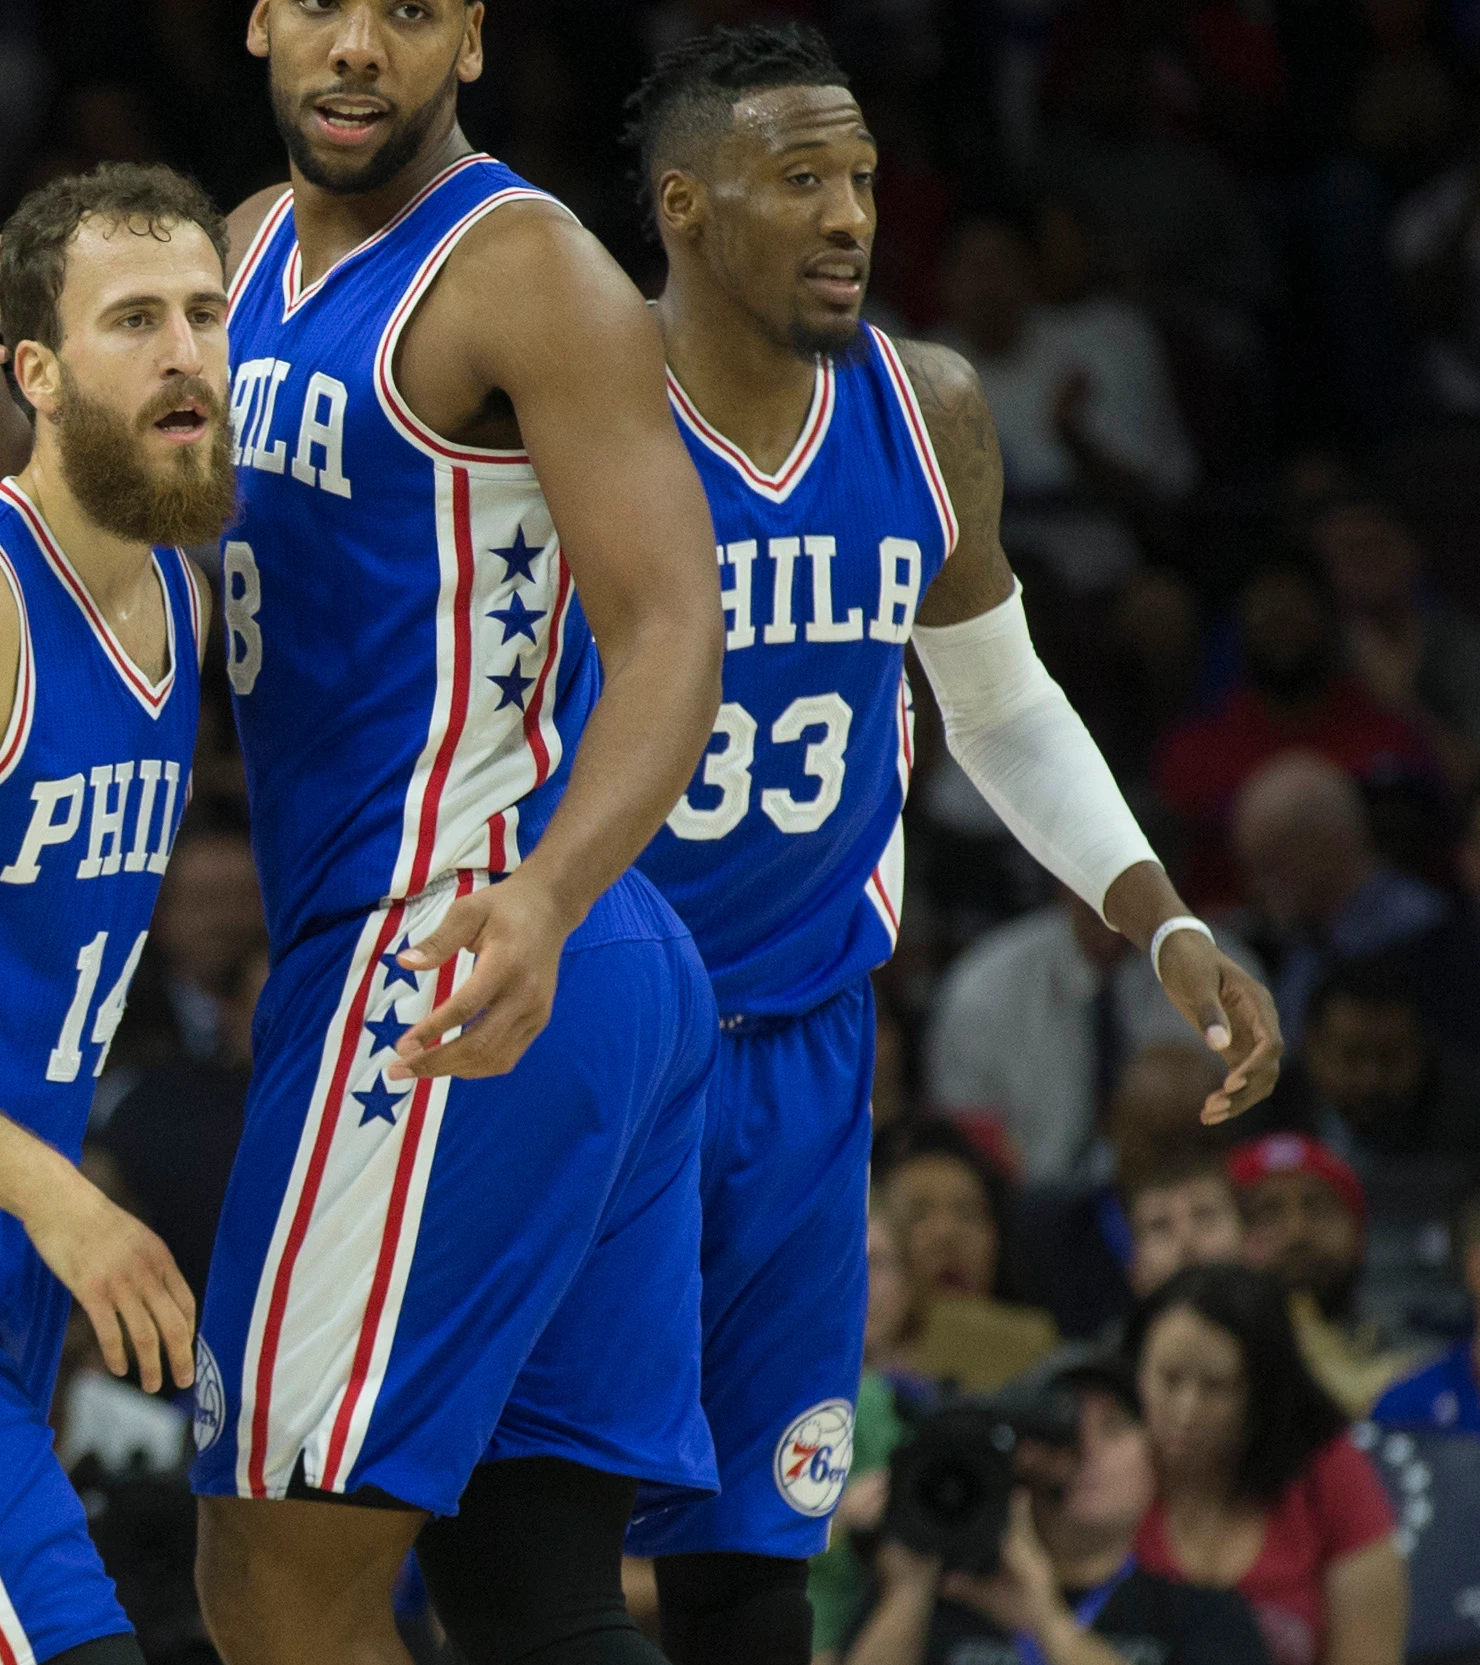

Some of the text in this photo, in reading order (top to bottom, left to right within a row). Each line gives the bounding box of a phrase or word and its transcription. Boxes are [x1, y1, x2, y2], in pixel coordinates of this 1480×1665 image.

[228, 357, 352, 500] HILA
[716, 535, 922, 652] HILA
[666, 692, 853, 841] 33
